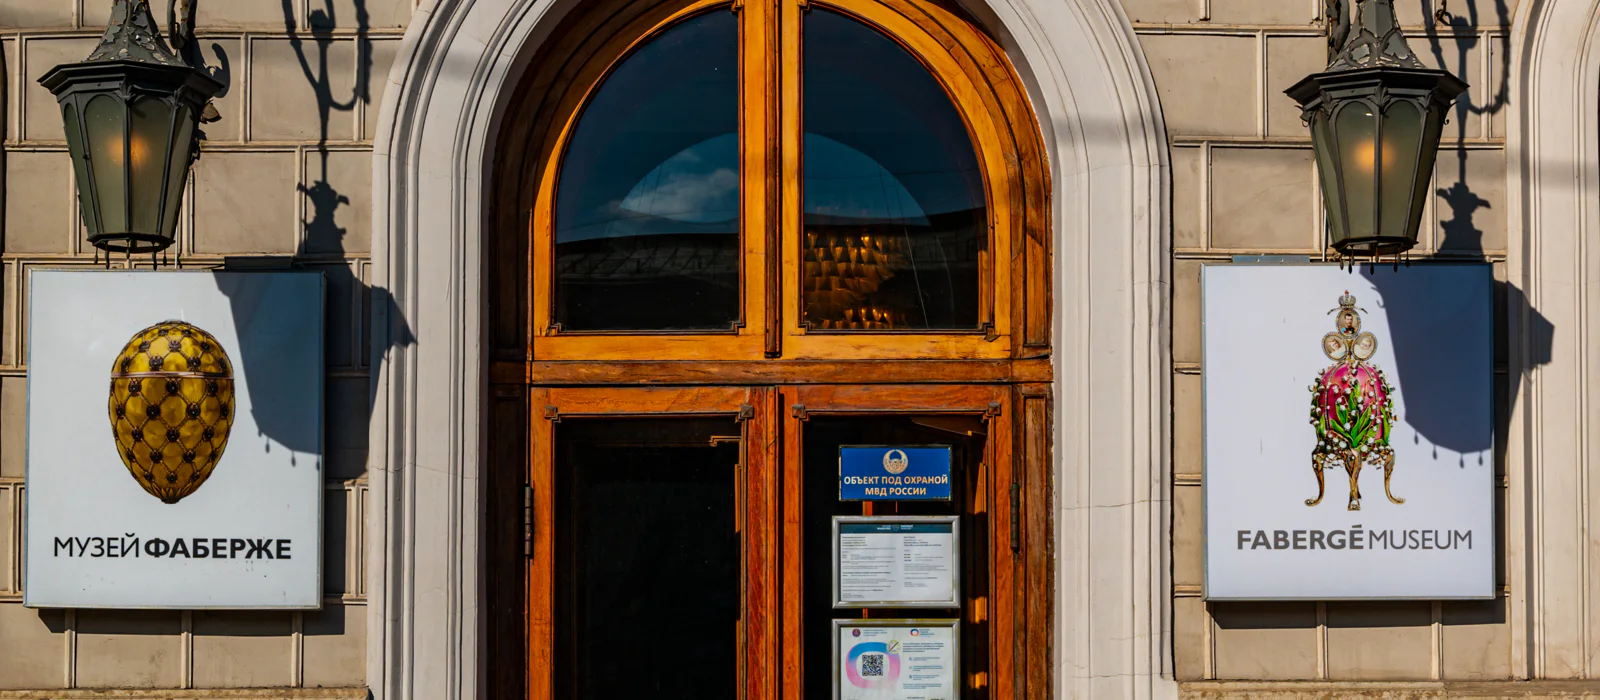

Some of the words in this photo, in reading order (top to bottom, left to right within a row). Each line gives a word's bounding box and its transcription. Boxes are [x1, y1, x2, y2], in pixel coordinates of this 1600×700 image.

[843, 476, 879, 485] ОБЪЕКТ
[881, 476, 902, 485] ПОД
[904, 474, 948, 485] ОХРАНОЙ
[865, 487, 887, 496] МВД
[889, 487, 926, 496] РОССИИ
[54, 532, 140, 558] МУЗЕЙ
[144, 537, 292, 559] ФАБЕРЖЕ
[1237, 524, 1364, 550] FABERGÉ
[1369, 529, 1473, 550] MUSEUM
